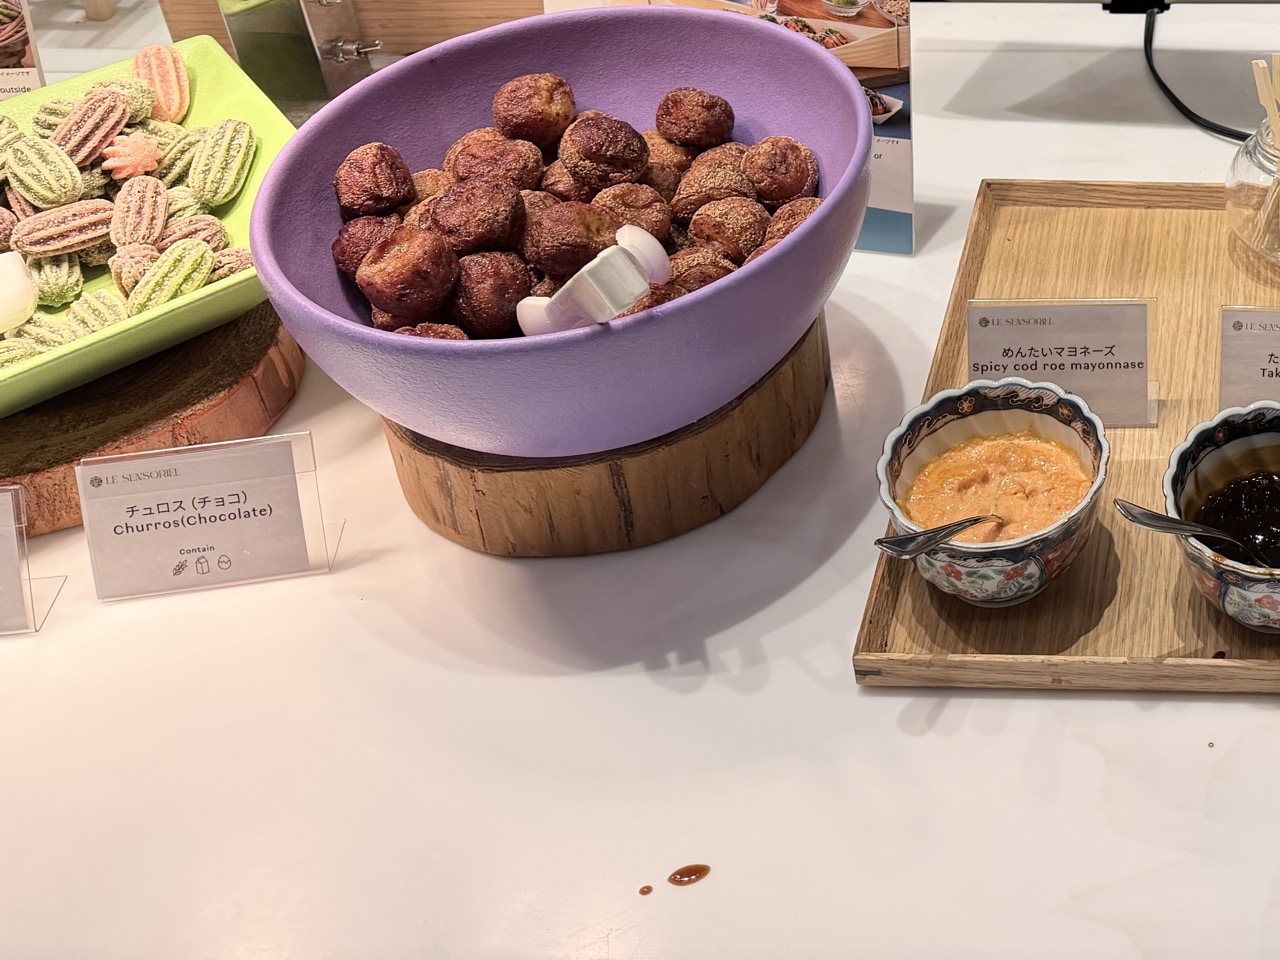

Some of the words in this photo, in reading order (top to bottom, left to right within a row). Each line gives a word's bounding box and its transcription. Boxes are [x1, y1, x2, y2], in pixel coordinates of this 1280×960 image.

[1002, 344, 1116, 358] めんたいマヨネーズ
[972, 361, 1009, 375] Spicy
[1013, 360, 1038, 371] cod
[1043, 362, 1066, 371] roe
[1070, 361, 1145, 373] mayonnase
[105, 474, 119, 485] LE
[121, 468, 182, 484] SENSORIEL
[113, 503, 274, 536] Churros(Chocolate)
[178, 543, 216, 556] Contain
